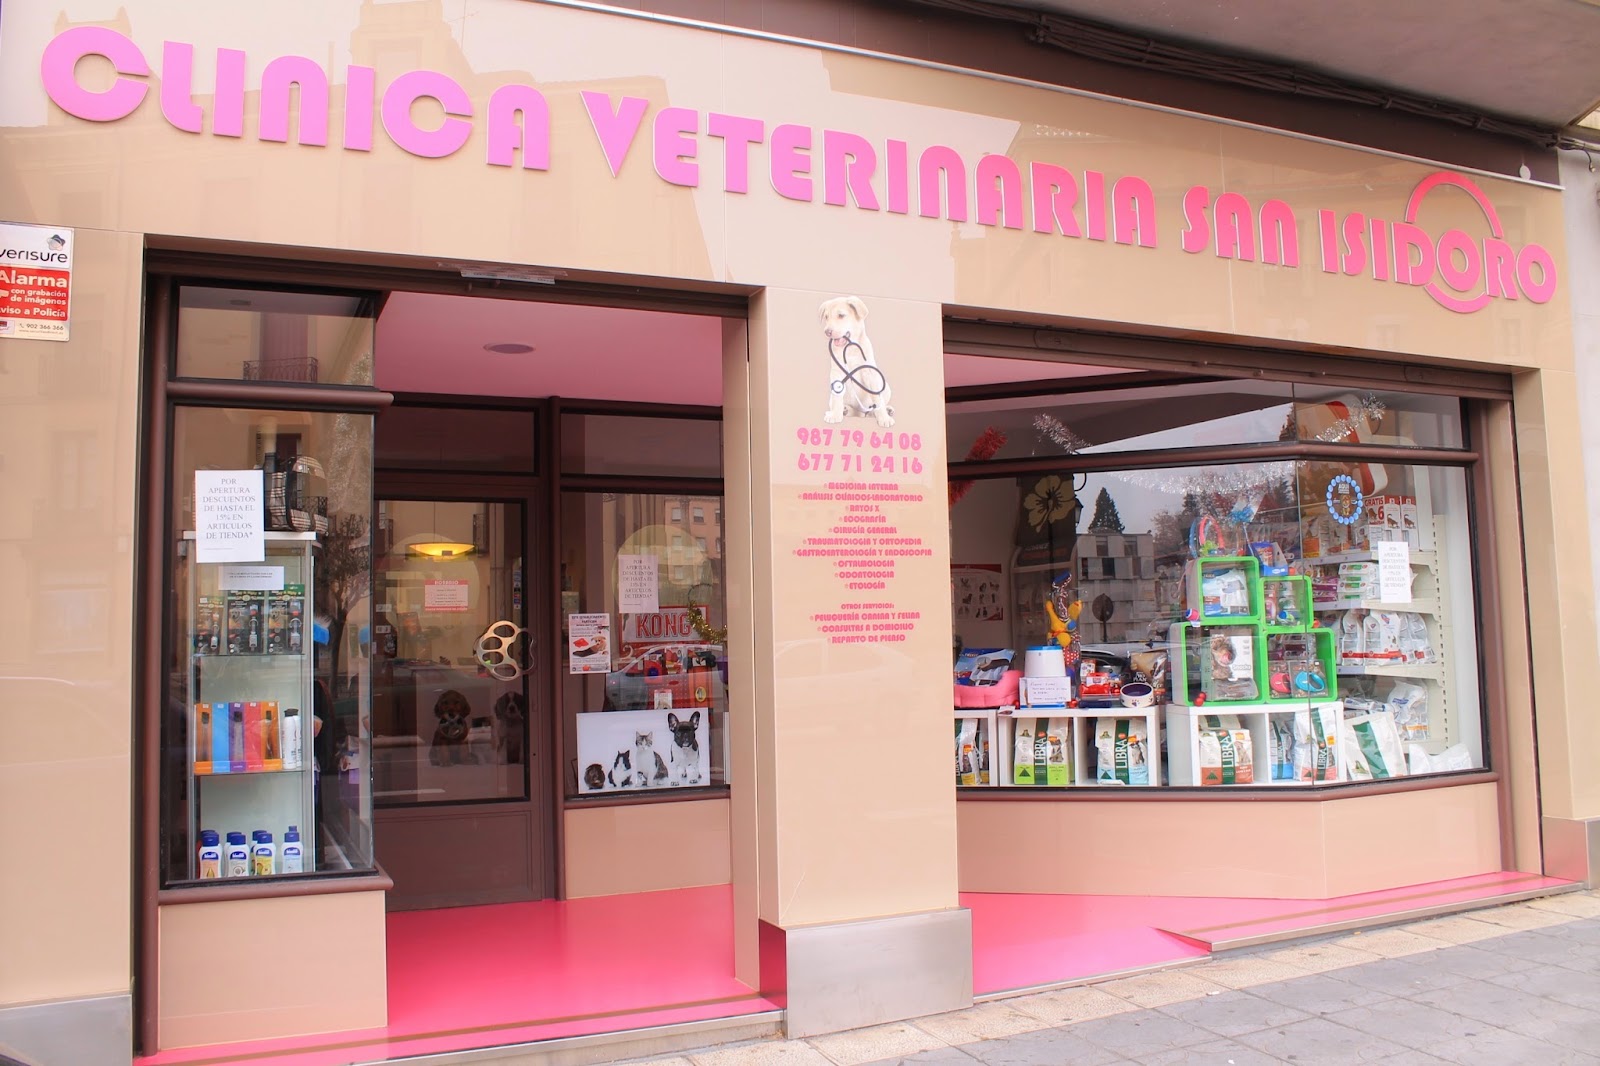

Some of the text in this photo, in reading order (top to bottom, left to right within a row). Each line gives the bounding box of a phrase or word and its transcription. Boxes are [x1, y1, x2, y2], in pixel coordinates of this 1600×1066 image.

[40, 25, 1557, 305] CLINICA VETERINARIA SAN ISIDORO
[0, 270, 67, 288] Alarma
[10, 294, 22, 302] de
[28, 288, 67, 298] grabación
[0, 306, 21, 314] viso
[33, 308, 66, 318] Policía
[797, 427, 922, 450] 987 79 64 08
[798, 453, 922, 474] 677 71 24 16
[828, 482, 898, 491] MEDICINA INTERNA
[802, 492, 834, 500] ANÁLISIS
[216, 504, 243, 512] HASTA
[844, 515, 886, 523] ECOGRAFÍA
[206, 522, 252, 530] ARTICULOS
[833, 526, 897, 534] CIRUGÍA GENERAL
[879, 538, 922, 546] ORTOPEDIA
[850, 580, 886, 590] ETOLOGÍA
[814, 612, 860, 622] PELUQUERÍA
[892, 612, 896, 620] Y
[898, 612, 920, 620] FELINA
[636, 612, 692, 638] KONG
[822, 623, 914, 632] CONSULTAS A DOMICILIO
[832, 635, 866, 644] REPARTO
[880, 634, 906, 642] PIENSO
[1034, 736, 1047, 766] LIBRA
[1115, 738, 1128, 768] LIBRA
[1220, 736, 1234, 768] LIBRA
